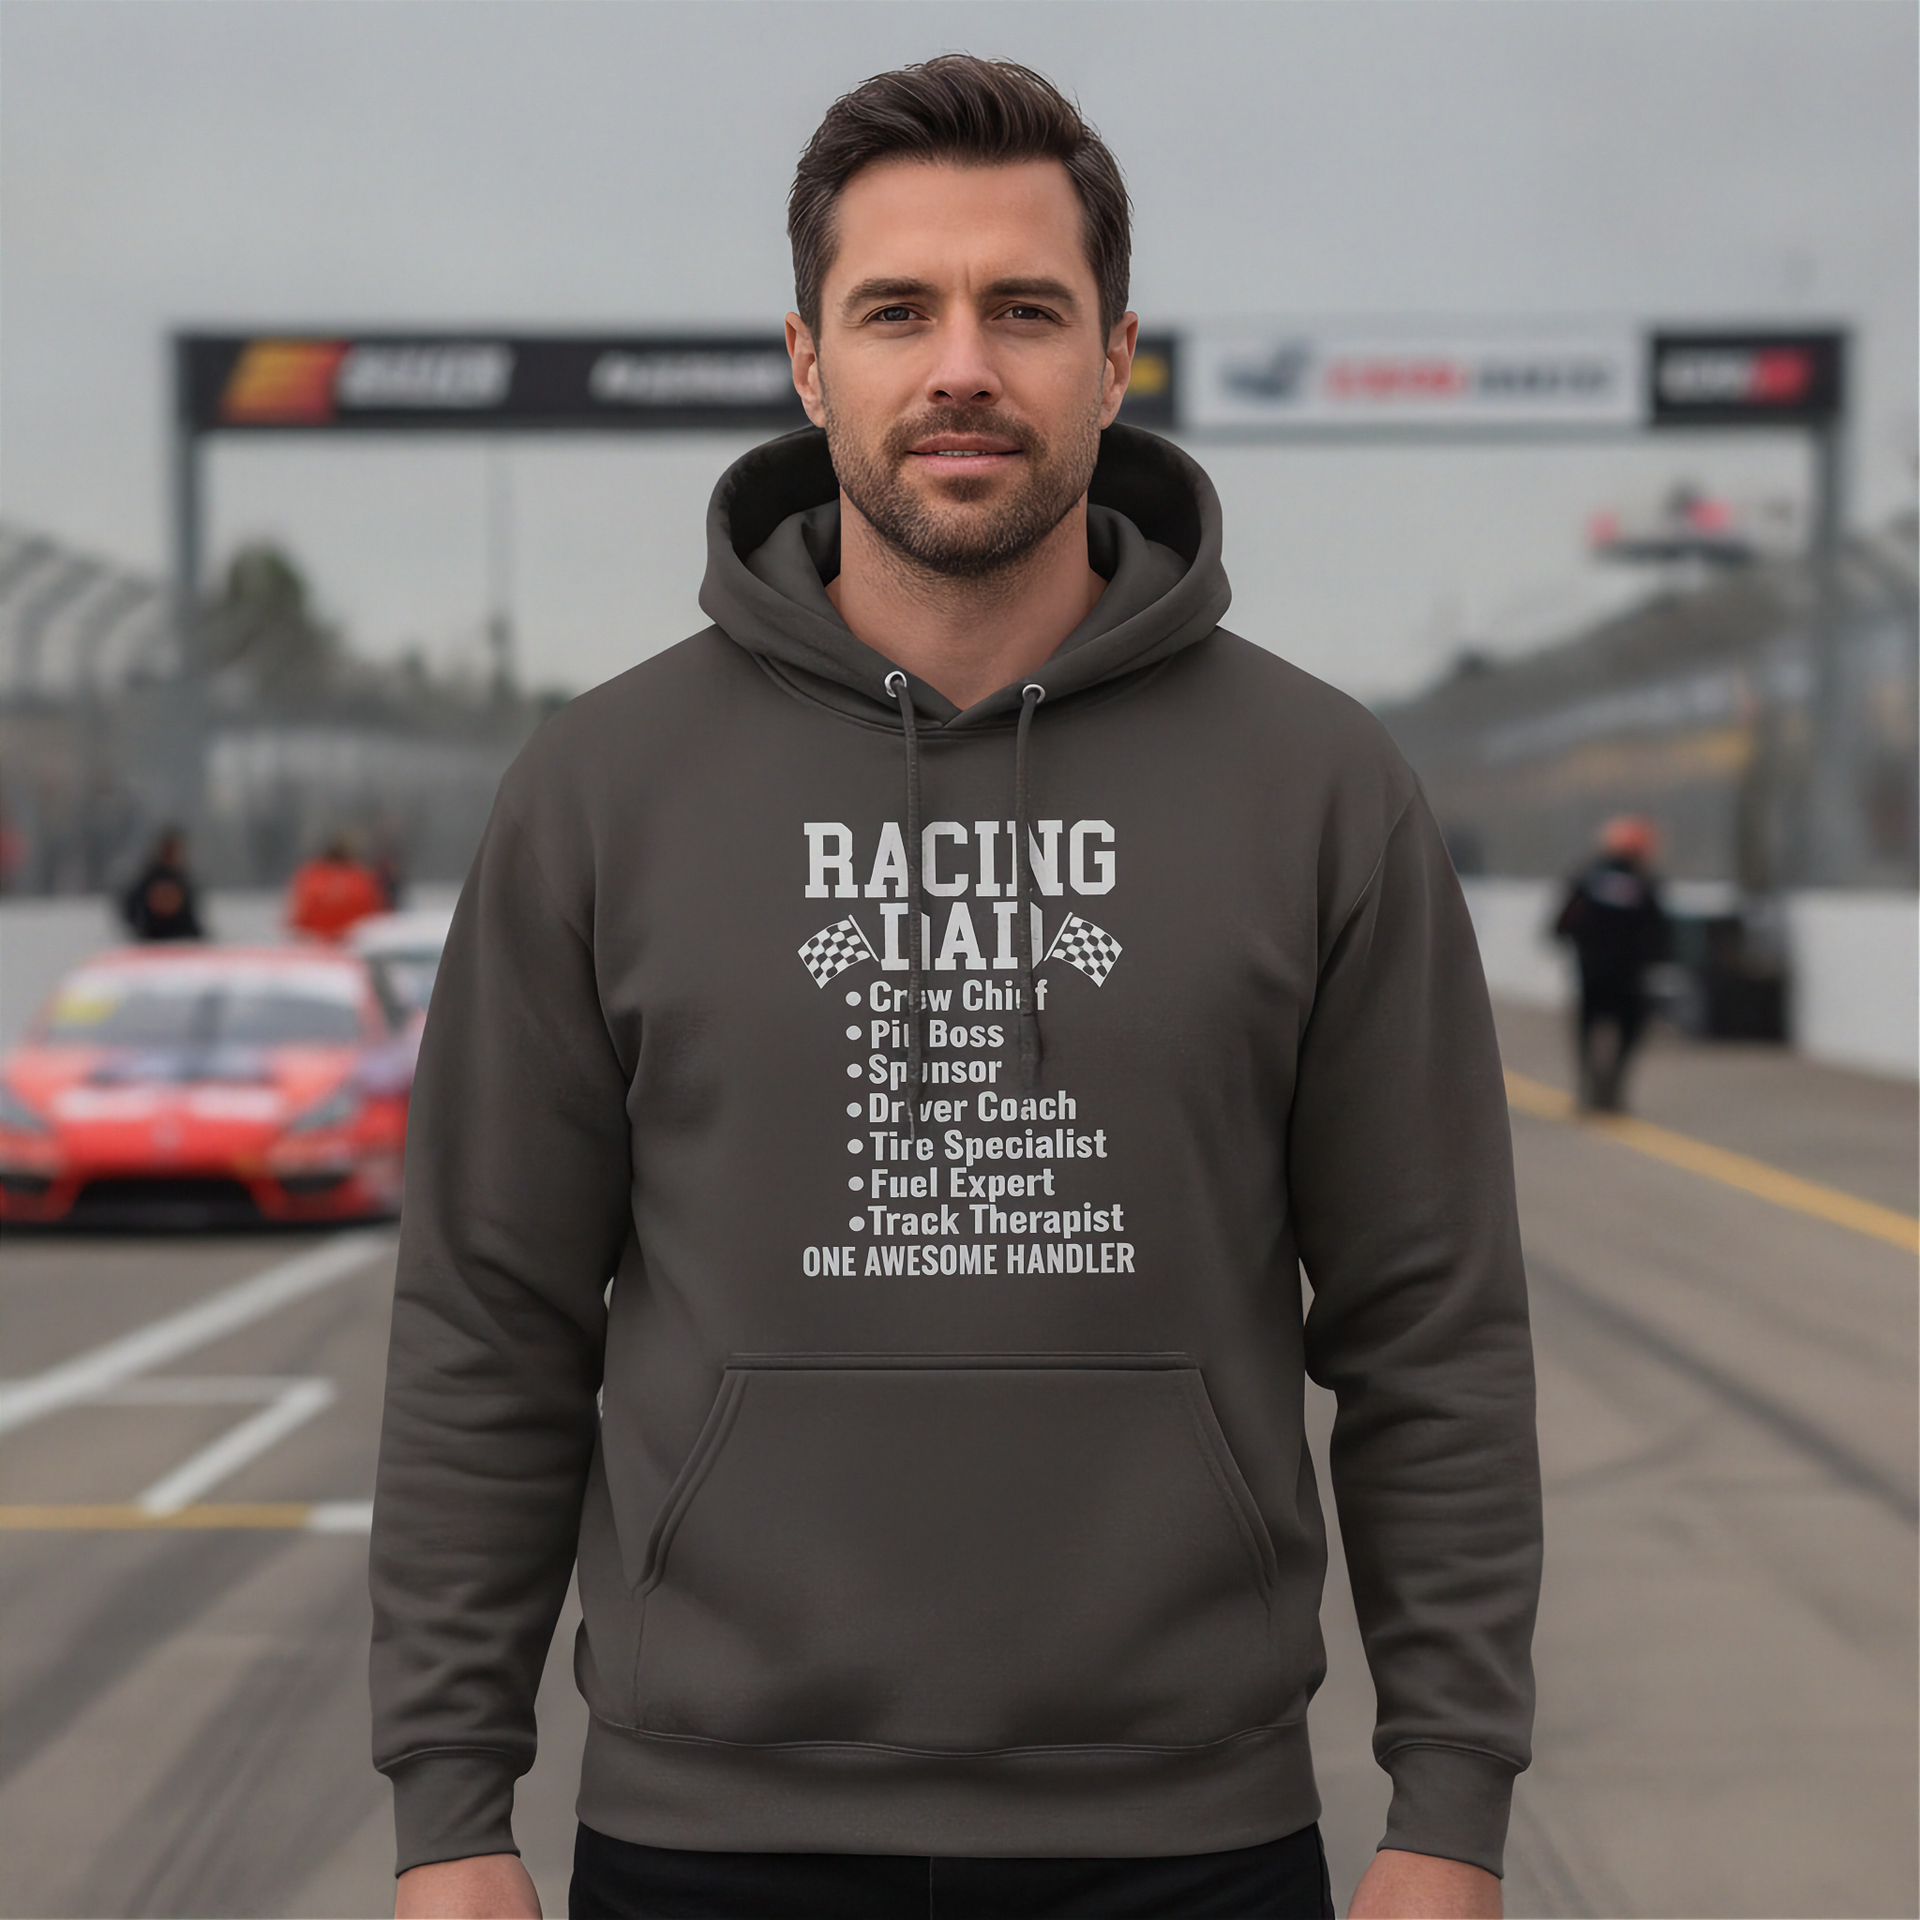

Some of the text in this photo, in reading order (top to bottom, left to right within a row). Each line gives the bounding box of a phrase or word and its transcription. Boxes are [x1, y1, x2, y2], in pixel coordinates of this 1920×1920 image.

[804, 820, 1115, 898] RACING
[963, 979, 1047, 1011] Chif
[930, 1020, 1004, 1047] Boss
[869, 1054, 1002, 1090] Spnsor
[870, 1090, 1076, 1122] Drver Coach
[870, 1129, 1107, 1166] Tire Specialist
[872, 1167, 1055, 1202] Fuel Expert
[868, 1202, 1124, 1238] Track Therapist
[803, 1243, 1135, 1276] ONE AWESOME HANDLER
